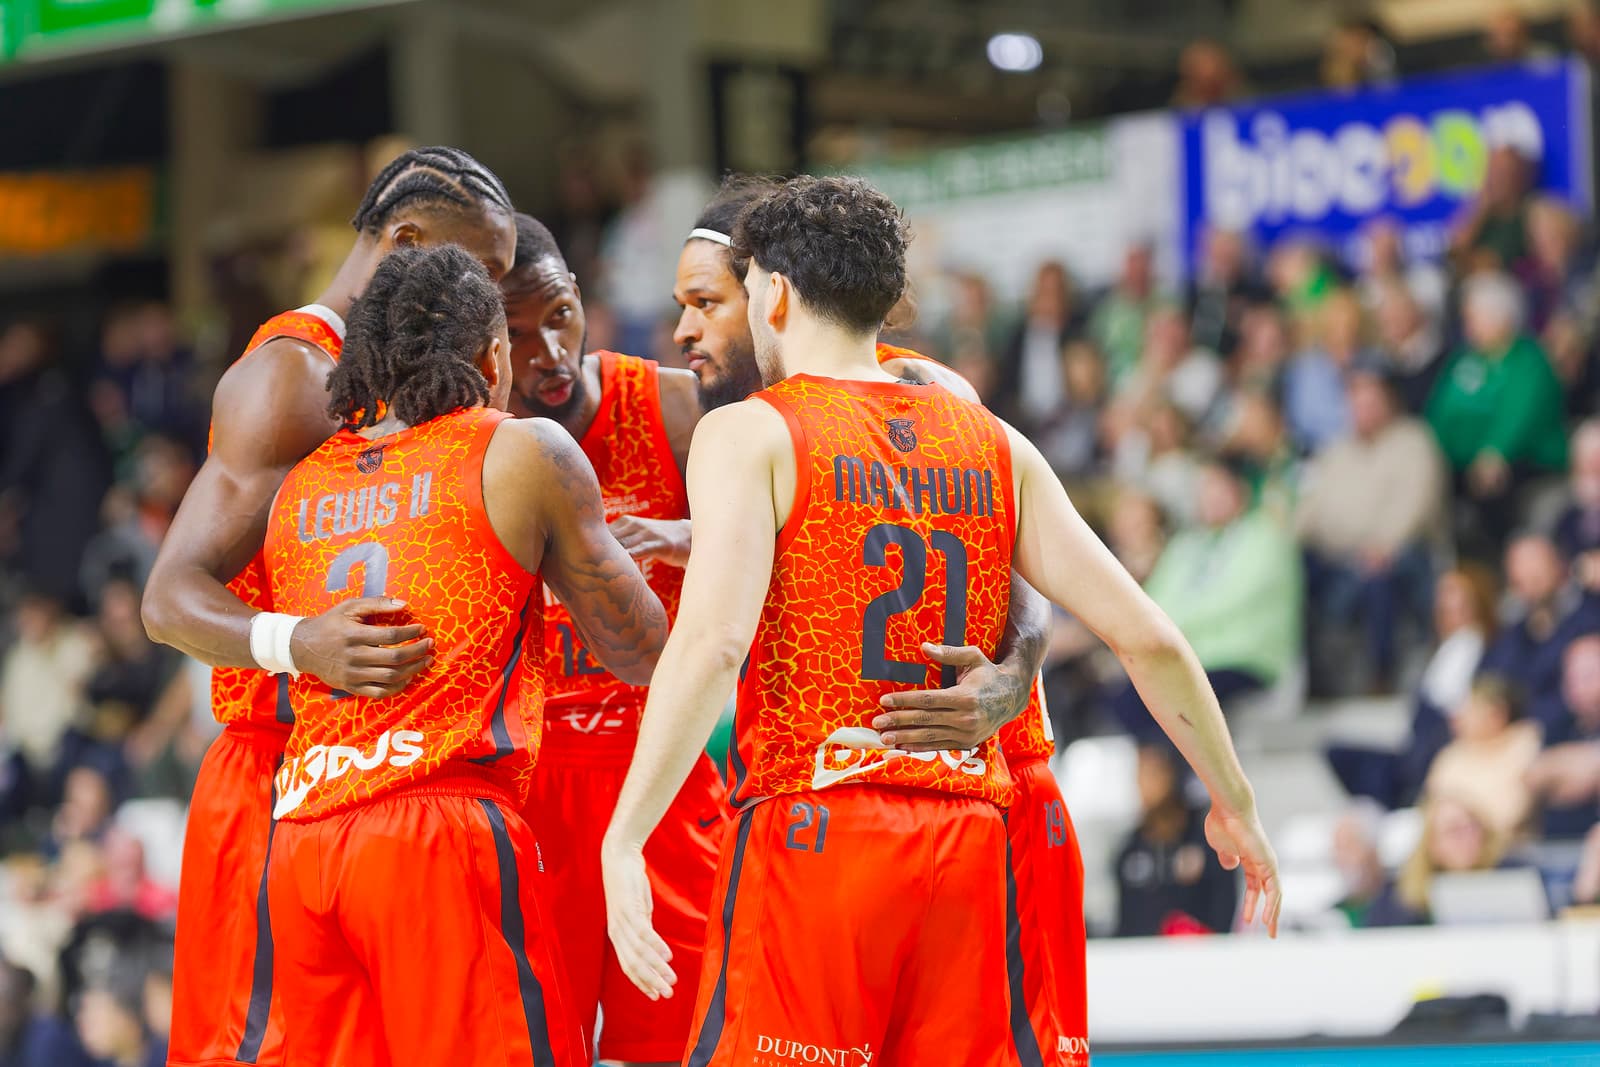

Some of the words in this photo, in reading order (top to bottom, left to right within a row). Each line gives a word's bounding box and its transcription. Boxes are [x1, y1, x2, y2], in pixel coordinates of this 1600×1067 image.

[298, 482, 401, 543] LEWIS
[409, 471, 433, 518] II
[833, 454, 994, 518] MAXHUNI
[861, 523, 968, 689] 21
[786, 802, 830, 854] 21
[1044, 799, 1067, 849] 19
[756, 1034, 850, 1067] DUPONT
